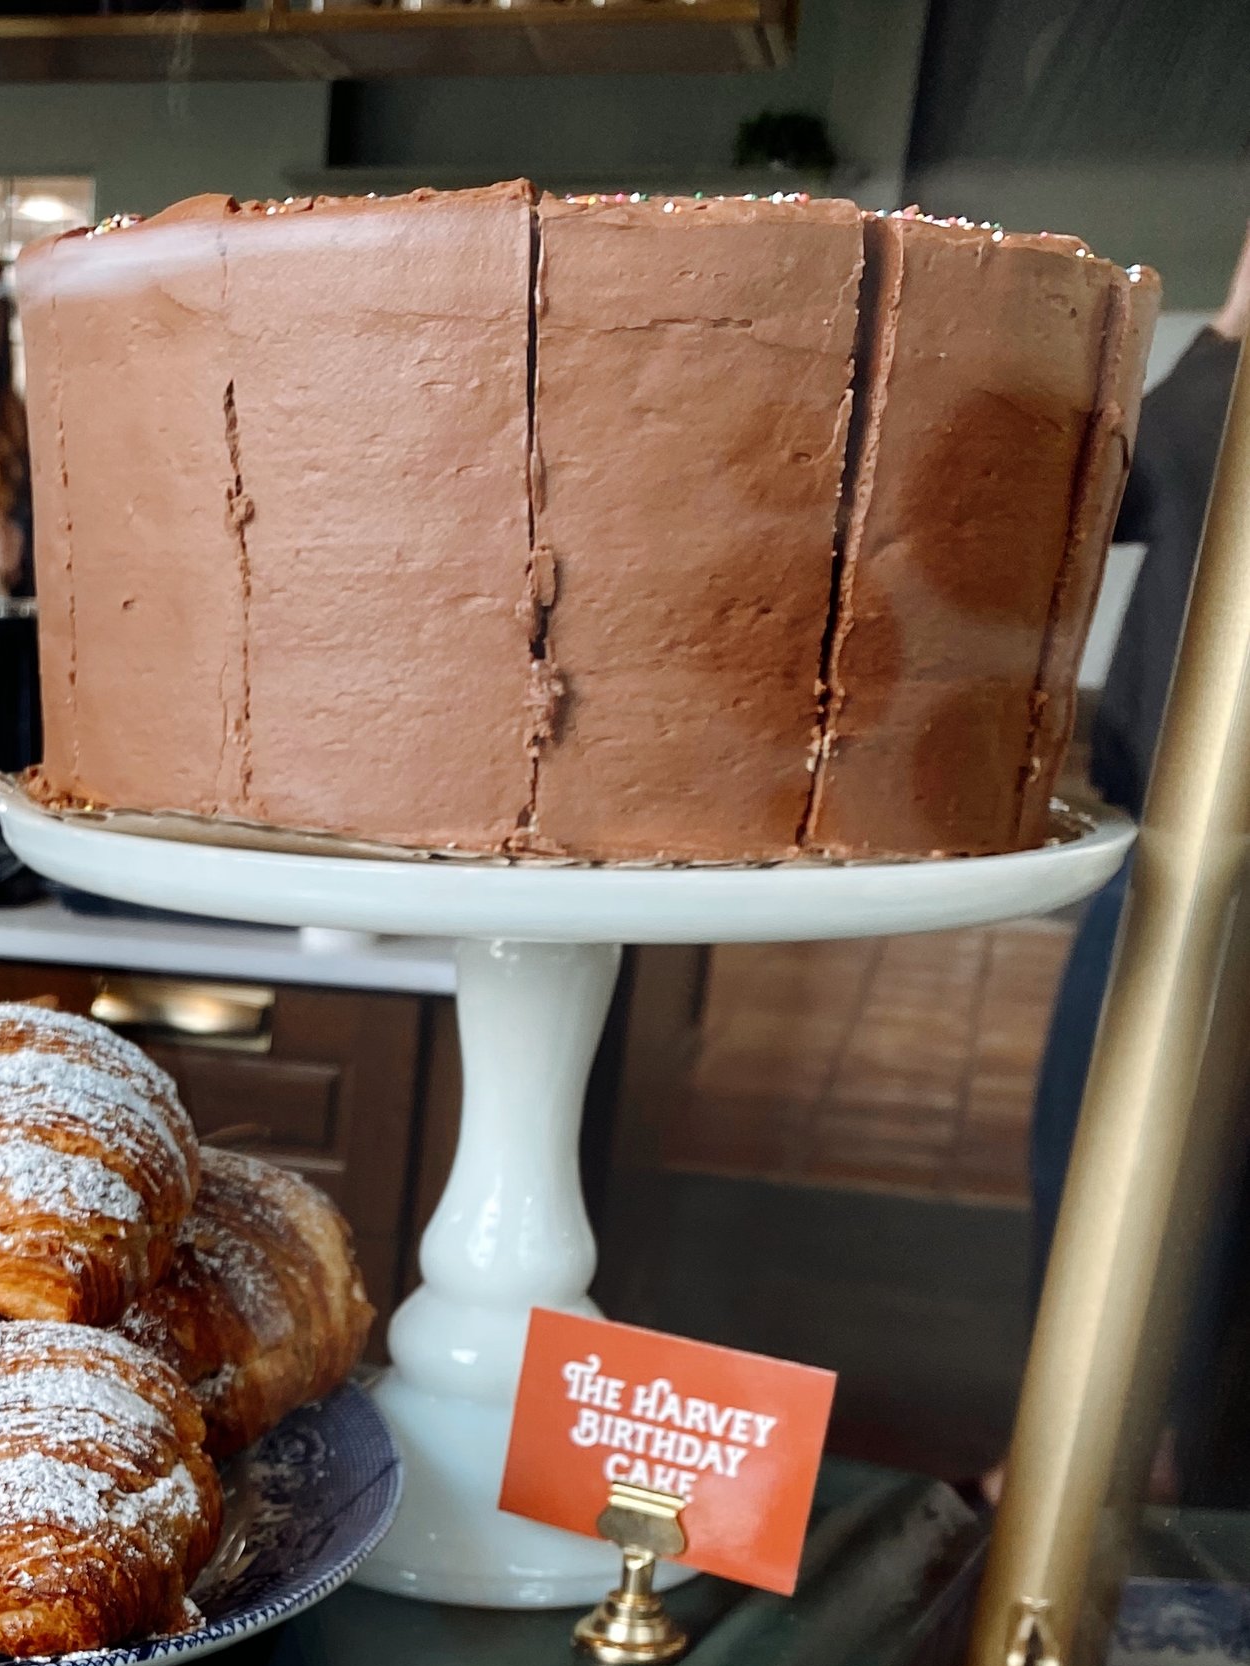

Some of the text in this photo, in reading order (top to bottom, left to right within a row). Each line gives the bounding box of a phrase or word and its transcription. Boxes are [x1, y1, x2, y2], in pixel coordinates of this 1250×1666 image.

[570, 1407, 749, 1480] BIRTHDAY
[631, 1377, 778, 1448] HARVEY
[604, 1452, 698, 1505] CAKE
